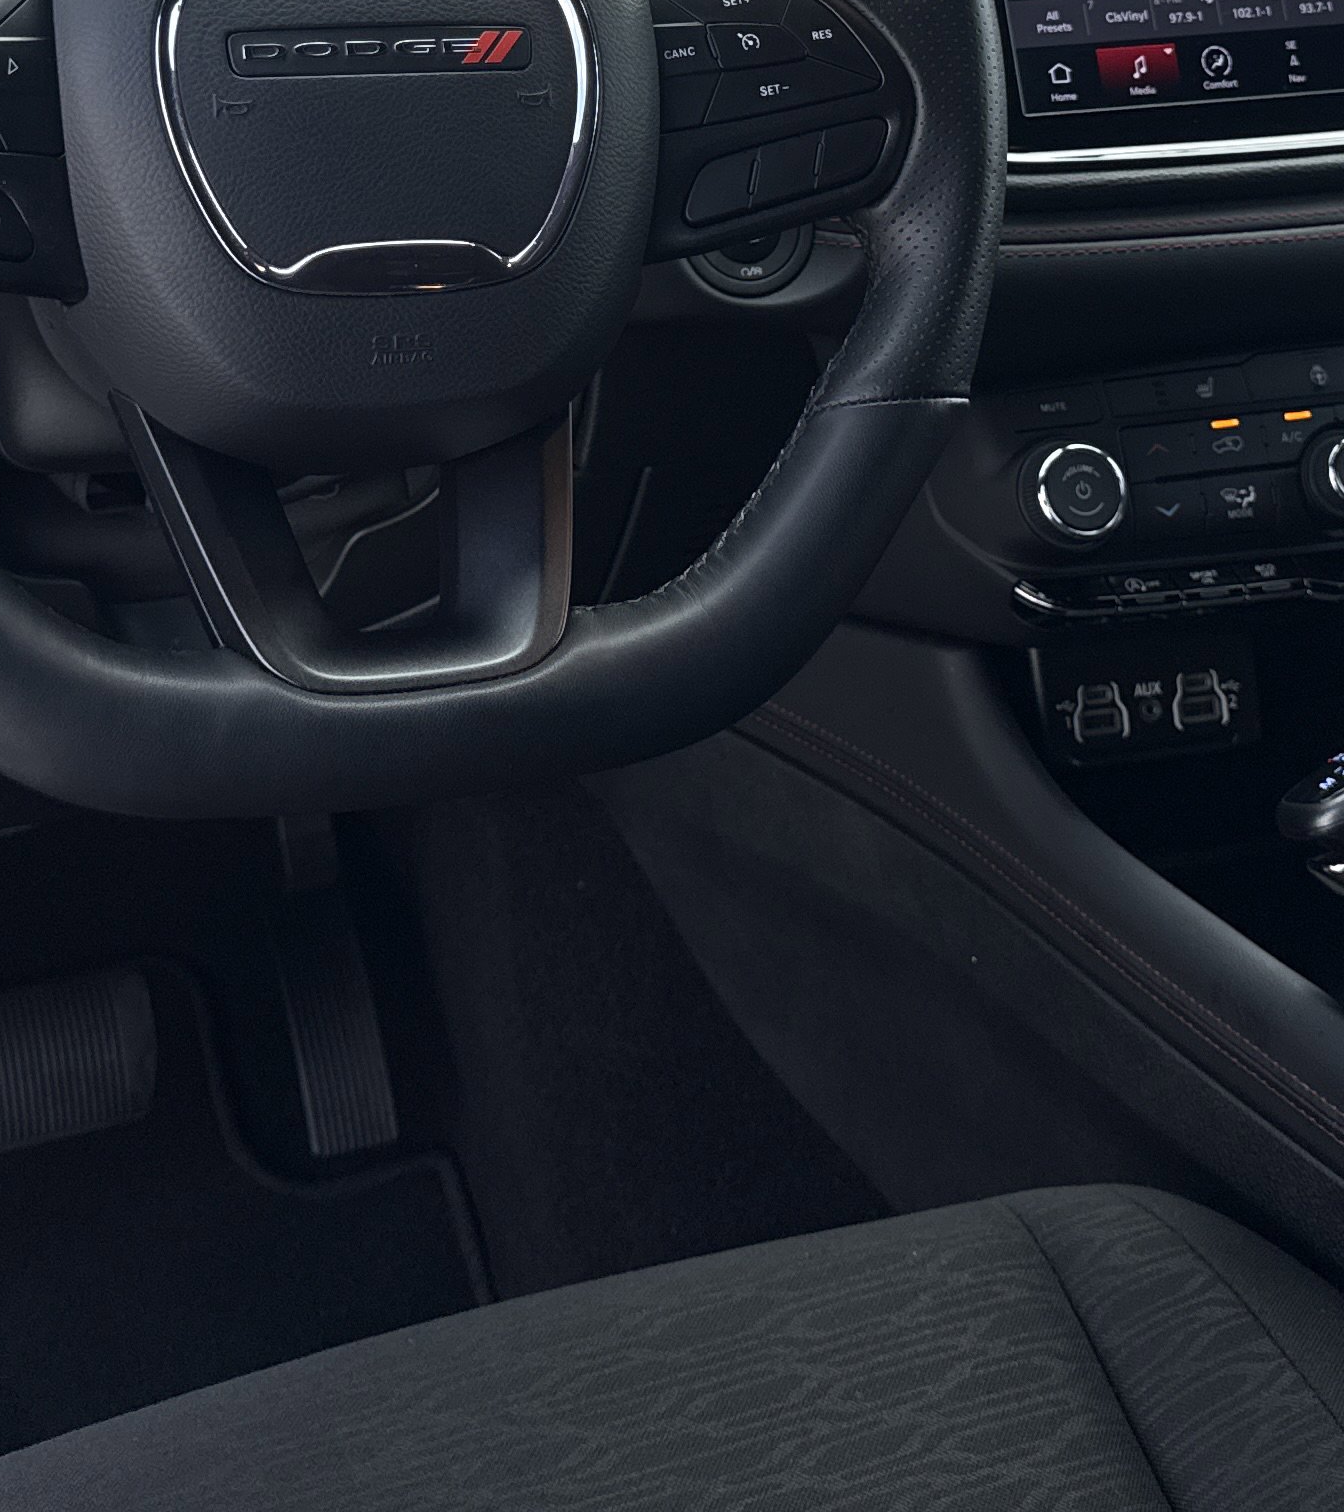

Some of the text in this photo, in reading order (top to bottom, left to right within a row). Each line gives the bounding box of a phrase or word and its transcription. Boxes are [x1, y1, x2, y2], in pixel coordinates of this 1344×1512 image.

[1087, 0, 1094, 11] 7
[1298, 0, 1334, 14] 93.7-1
[1045, 10, 1059, 21] All
[1168, 10, 1205, 24] 97.9-1
[1232, 6, 1273, 20] 102.1-1
[1036, 22, 1072, 34] Presets
[811, 28, 834, 41] RES
[241, 37, 483, 62] DODGE
[663, 45, 696, 61] CANC
[1203, 78, 1239, 90] Comfort
[1288, 73, 1307, 84] Nav
[1129, 85, 1157, 96] Media
[1050, 92, 1079, 103] Home
[1039, 401, 1068, 413] MUTE
[1227, 508, 1255, 519] MODE
[1134, 680, 1164, 698] AUX
